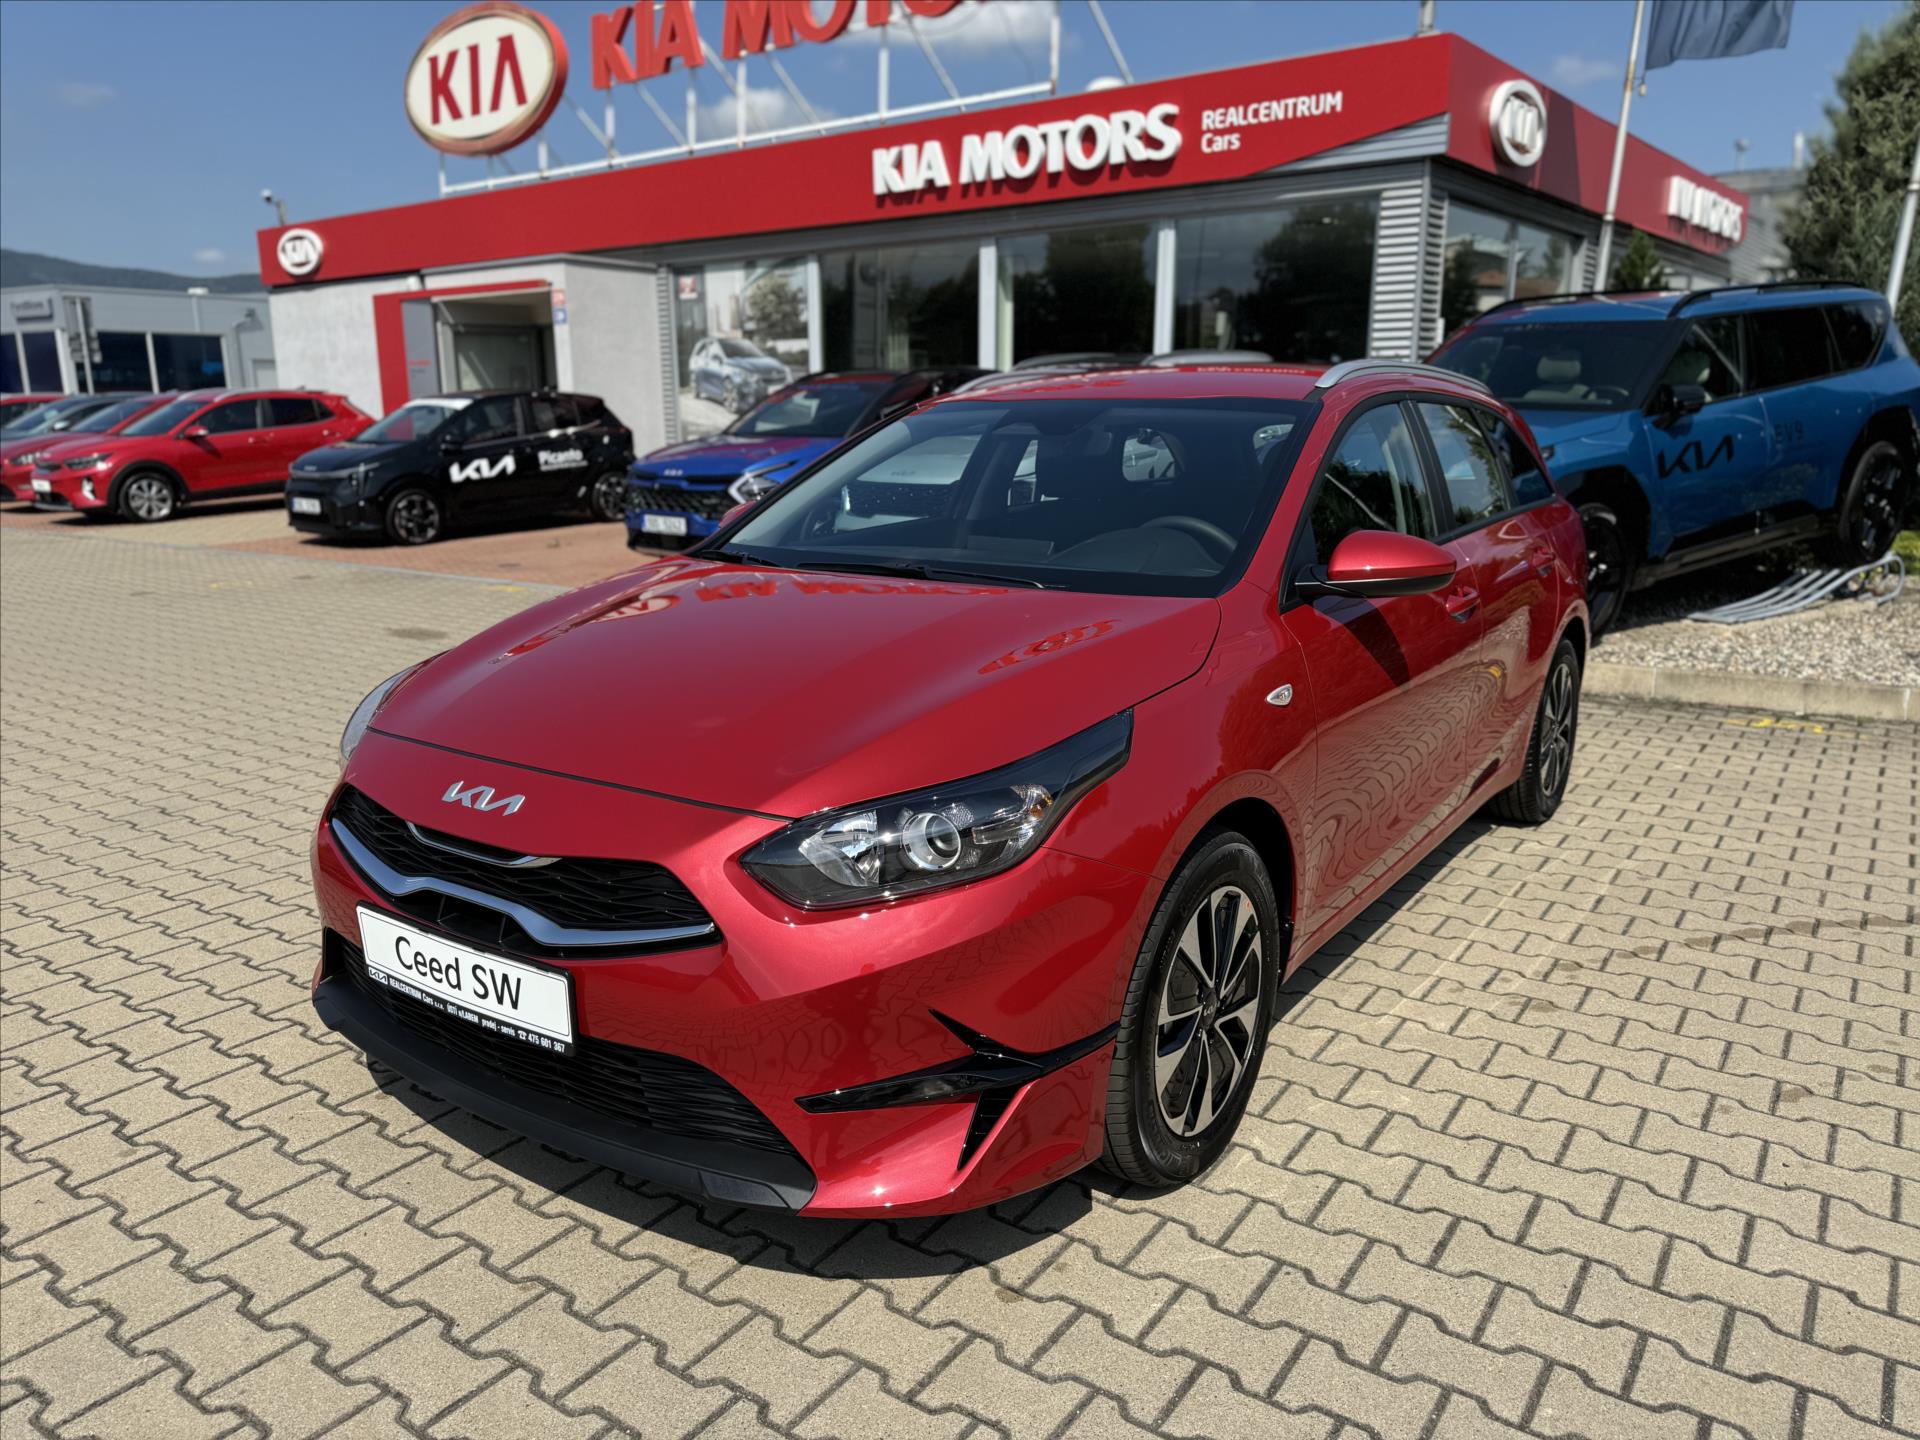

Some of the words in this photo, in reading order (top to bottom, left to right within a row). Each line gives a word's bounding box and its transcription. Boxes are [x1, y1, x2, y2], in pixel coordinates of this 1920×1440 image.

[428, 34, 527, 125] KIA
[592, 0, 704, 89] KIA
[1201, 132, 1241, 154] Cars
[1202, 90, 1343, 131] REALCENTRUM
[872, 140, 951, 194] KIA
[959, 103, 1182, 184] MOTORS
[449, 454, 516, 483] KIA
[538, 448, 584, 466] Picanto
[441, 780, 526, 816] KIA
[395, 936, 462, 991] Ceed
[472, 964, 521, 1010] SW
[390, 978, 422, 1000] REALCENTRUM
[422, 993, 433, 1005] Cars
[482, 1018, 497, 1032] prodej
[501, 1025, 516, 1037] servis
[528, 1033, 540, 1045] 475
[540, 1037, 552, 1049] 601
[554, 1041, 565, 1053] 367
